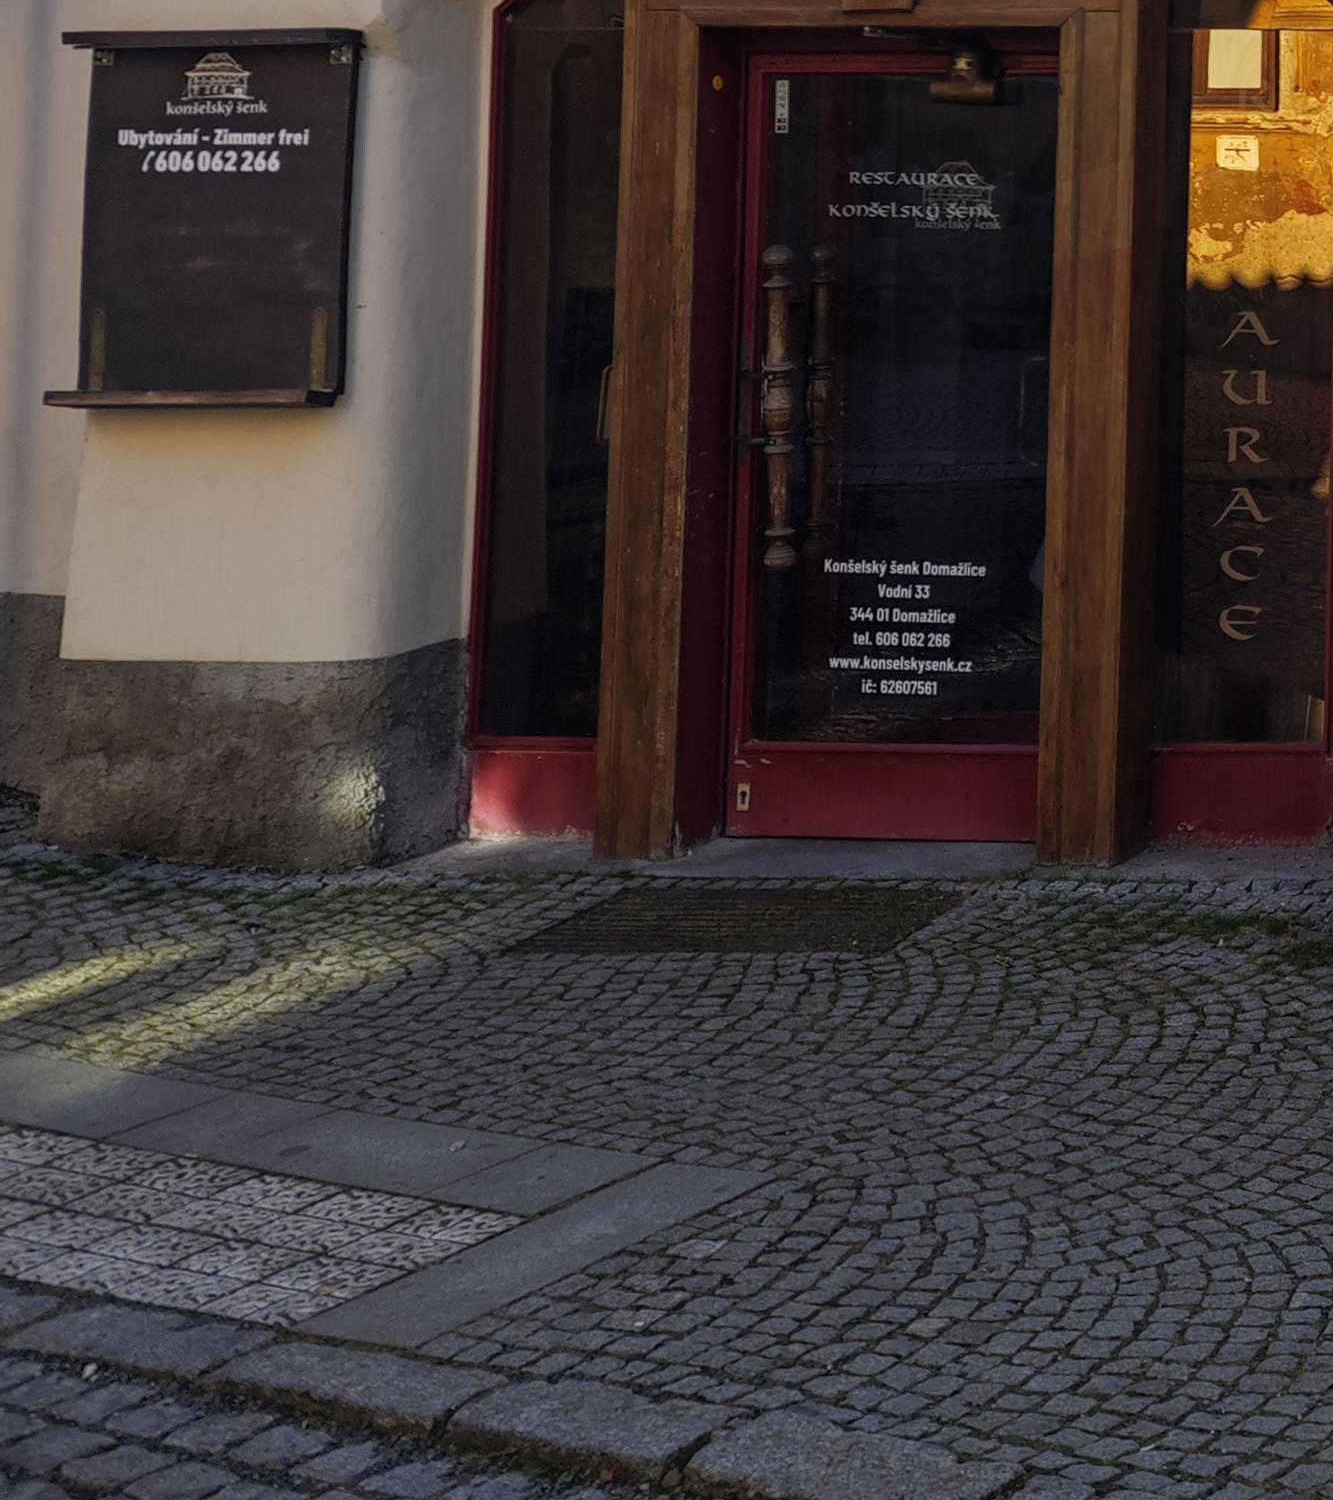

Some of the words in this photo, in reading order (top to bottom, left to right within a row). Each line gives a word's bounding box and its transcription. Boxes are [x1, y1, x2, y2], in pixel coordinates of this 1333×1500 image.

[166, 101, 235, 117] konšelský
[236, 100, 268, 114] šenk
[117, 128, 199, 149] Ubytování
[213, 128, 275, 145] Zimmer
[278, 128, 310, 146] frei
[154, 151, 194, 172] 606
[197, 150, 238, 172] 062
[240, 151, 280, 172] 266
[849, 171, 979, 186] RESTAURACE
[824, 558, 887, 577] Konšelský
[889, 560, 920, 575] šenk
[923, 561, 986, 577] Domažlice
[878, 583, 912, 599] Vodní
[914, 585, 931, 599] 33
[850, 607, 873, 621] 344
[876, 608, 889, 621] 01
[892, 608, 956, 623] Domažlice
[853, 631, 872, 645] tel.
[875, 632, 899, 646] 606
[901, 632, 925, 647] 062
[927, 633, 951, 647] 266
[829, 655, 972, 674] www.konselskysenk.cz
[861, 679, 877, 693] ič:
[880, 680, 938, 695] 62607561
